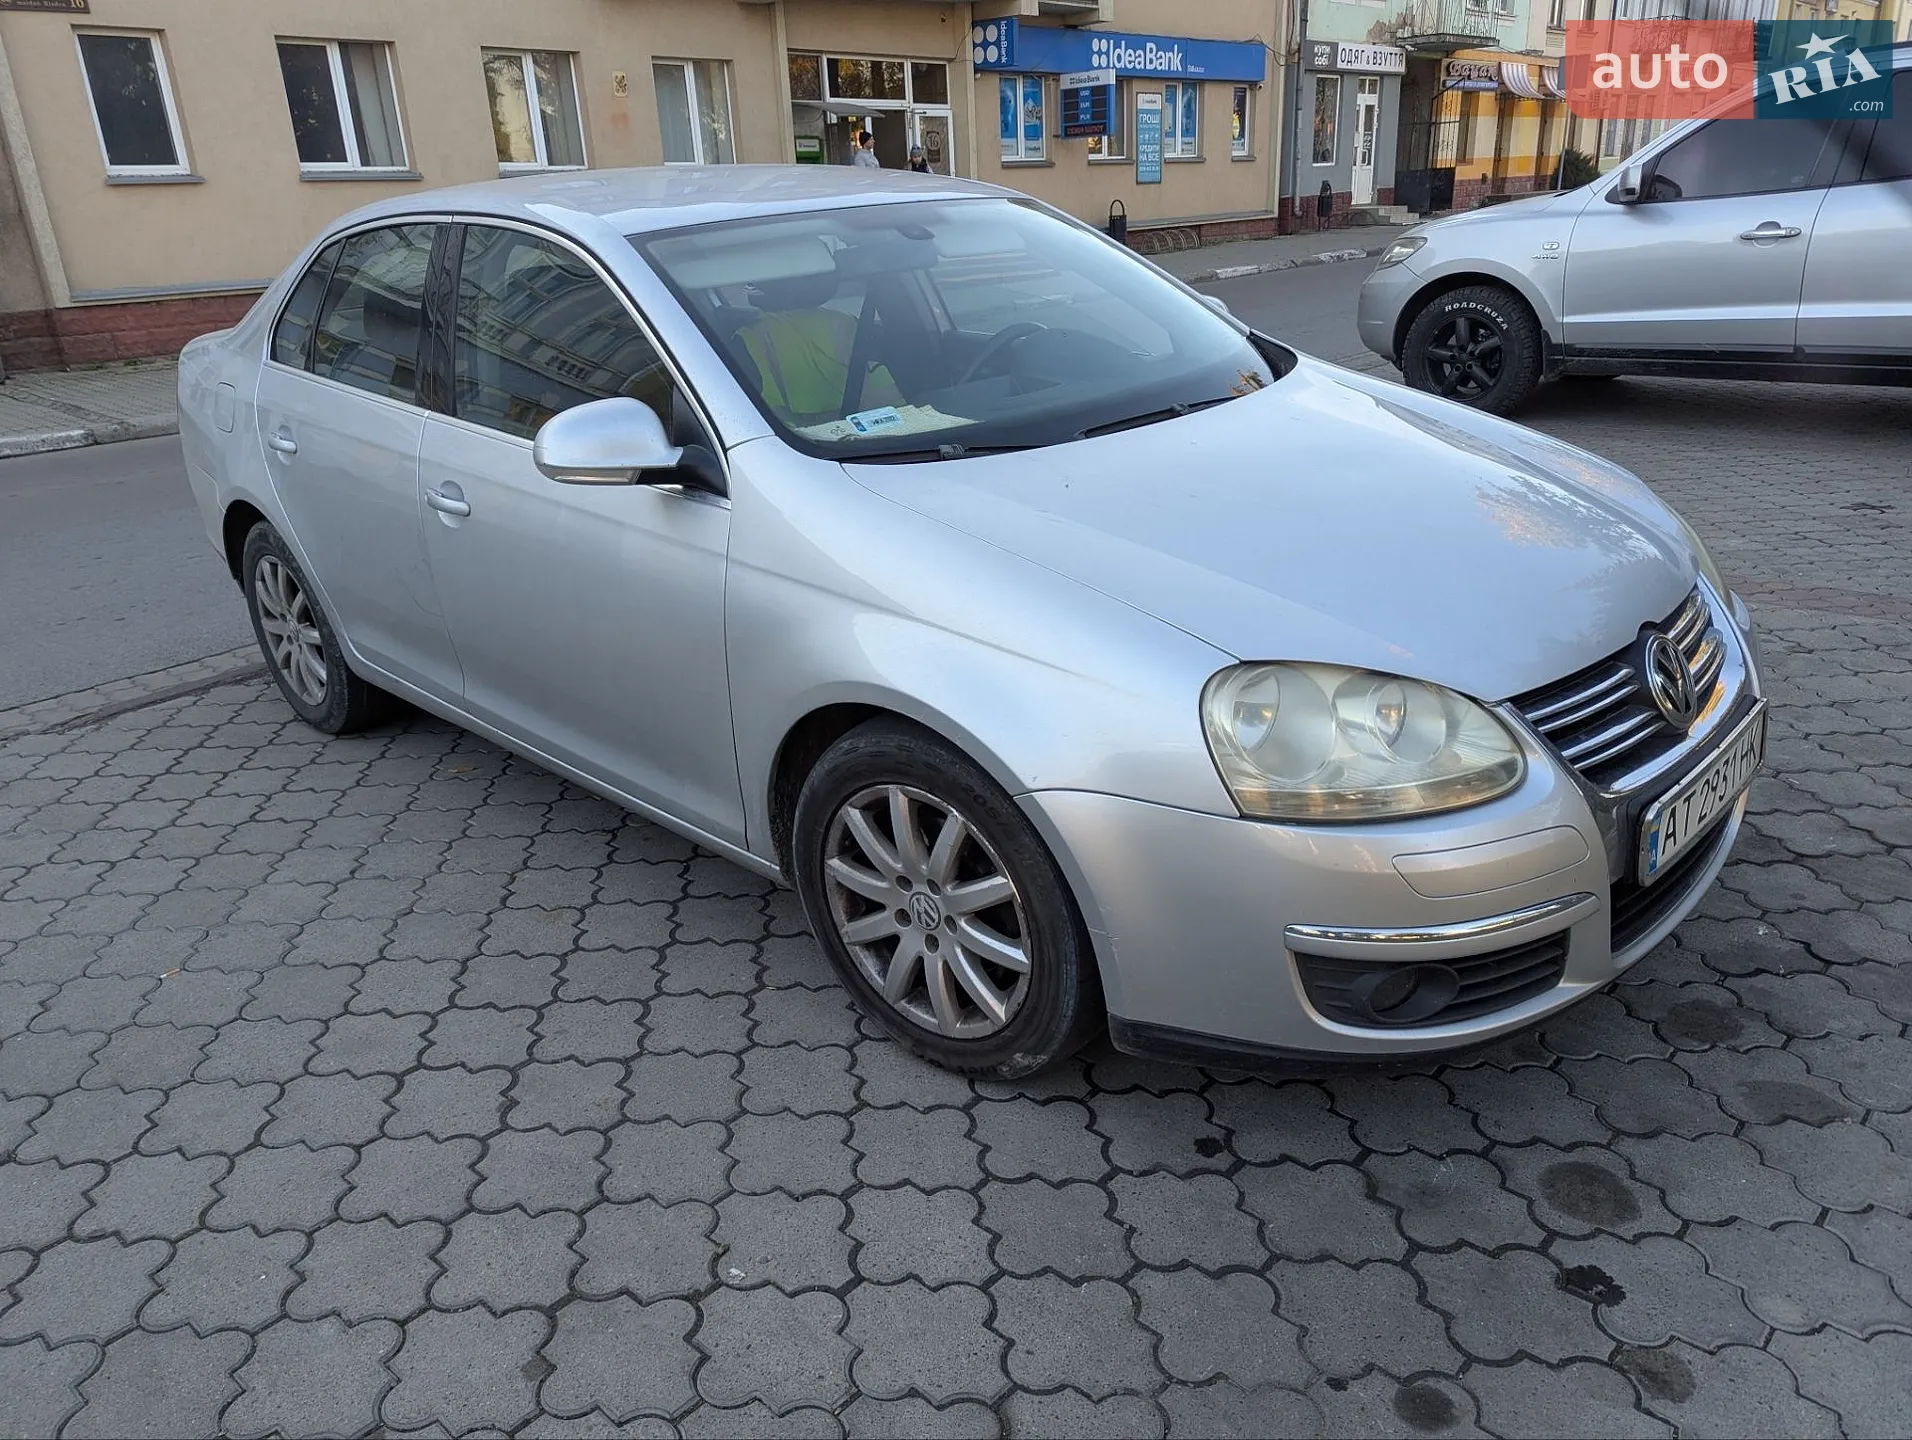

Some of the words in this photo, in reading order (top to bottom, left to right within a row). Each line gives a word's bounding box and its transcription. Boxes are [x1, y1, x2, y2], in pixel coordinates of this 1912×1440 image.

[1340, 47, 1365, 66] ОДЯГ
[1372, 50, 1404, 67] ВЗУТТЯ
[1445, 301, 1508, 330] ROADCRUZA
[1662, 789, 1696, 857] AT
[1698, 747, 1738, 825] 2931
[1740, 719, 1761, 781] HK
